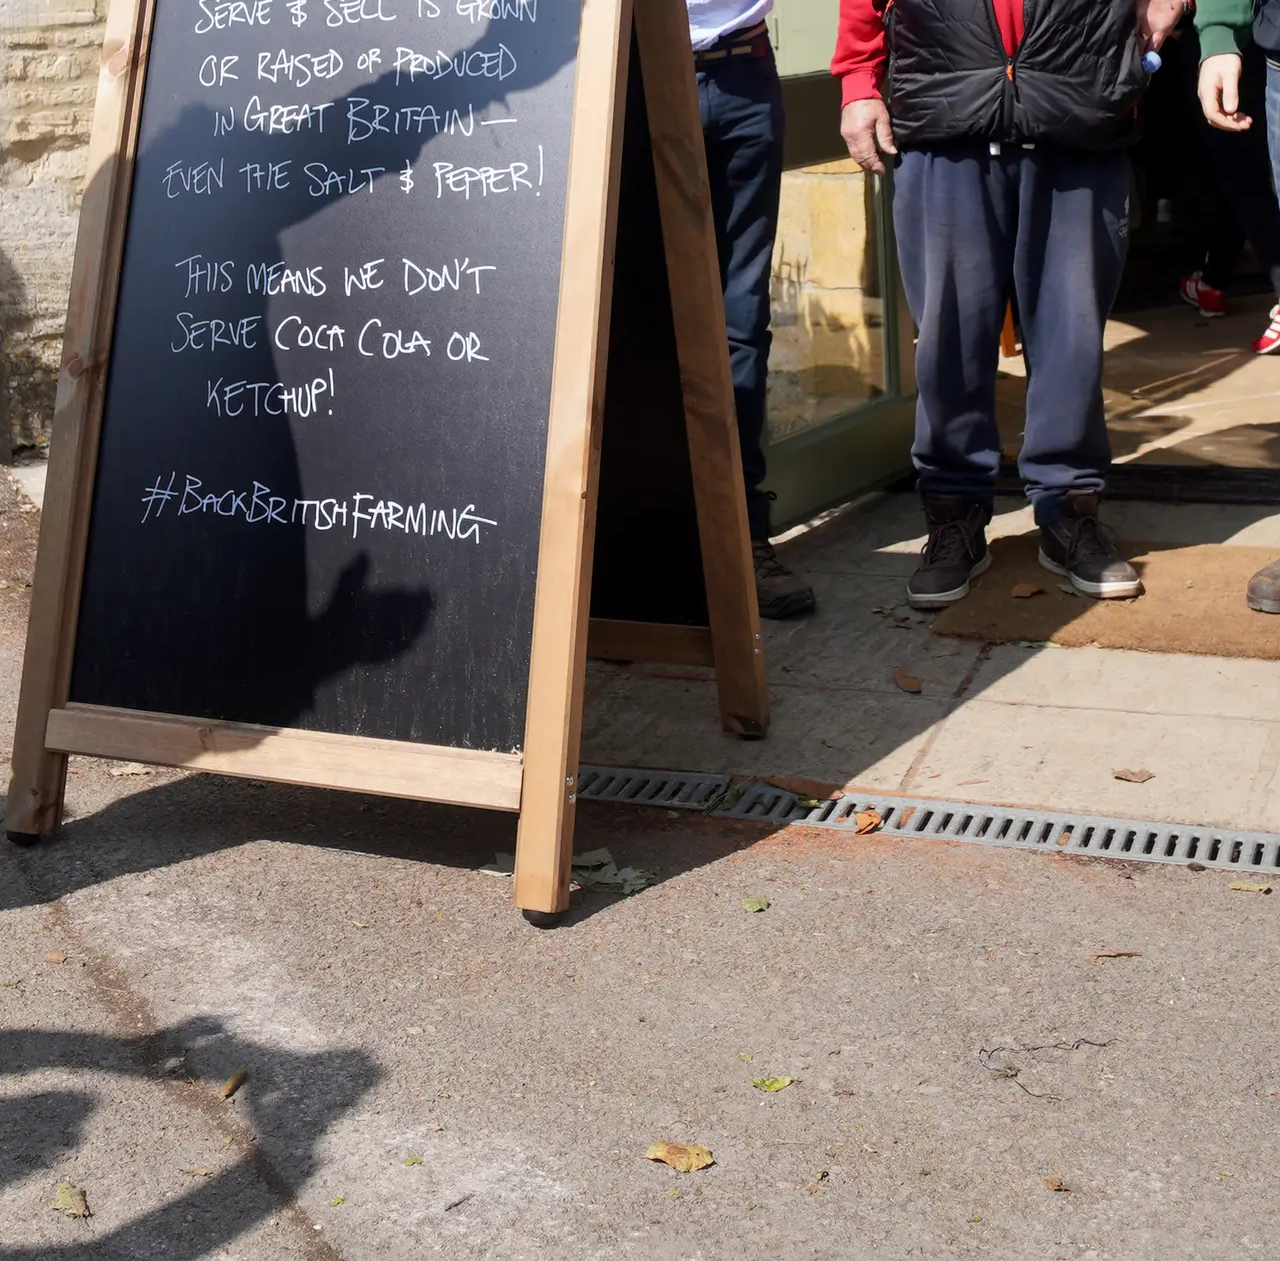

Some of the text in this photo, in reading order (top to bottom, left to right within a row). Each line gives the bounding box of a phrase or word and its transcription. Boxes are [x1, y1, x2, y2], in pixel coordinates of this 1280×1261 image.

[198, 42, 518, 88] OR RAISED OR PRODUCED
[213, 106, 235, 137] IN
[243, 94, 335, 135] GREAT
[161, 157, 225, 199] EVEN
[238, 159, 293, 194] THE
[305, 161, 386, 197] SALT
[432, 144, 544, 201] PEPPER!
[174, 254, 497, 299] THIS MEANS WE DON'T
[170, 311, 491, 363] SERVE COCA COLA OR
[206, 367, 335, 418] KETCHUP!
[140, 470, 499, 544] #BACKBRITISHFARMING
